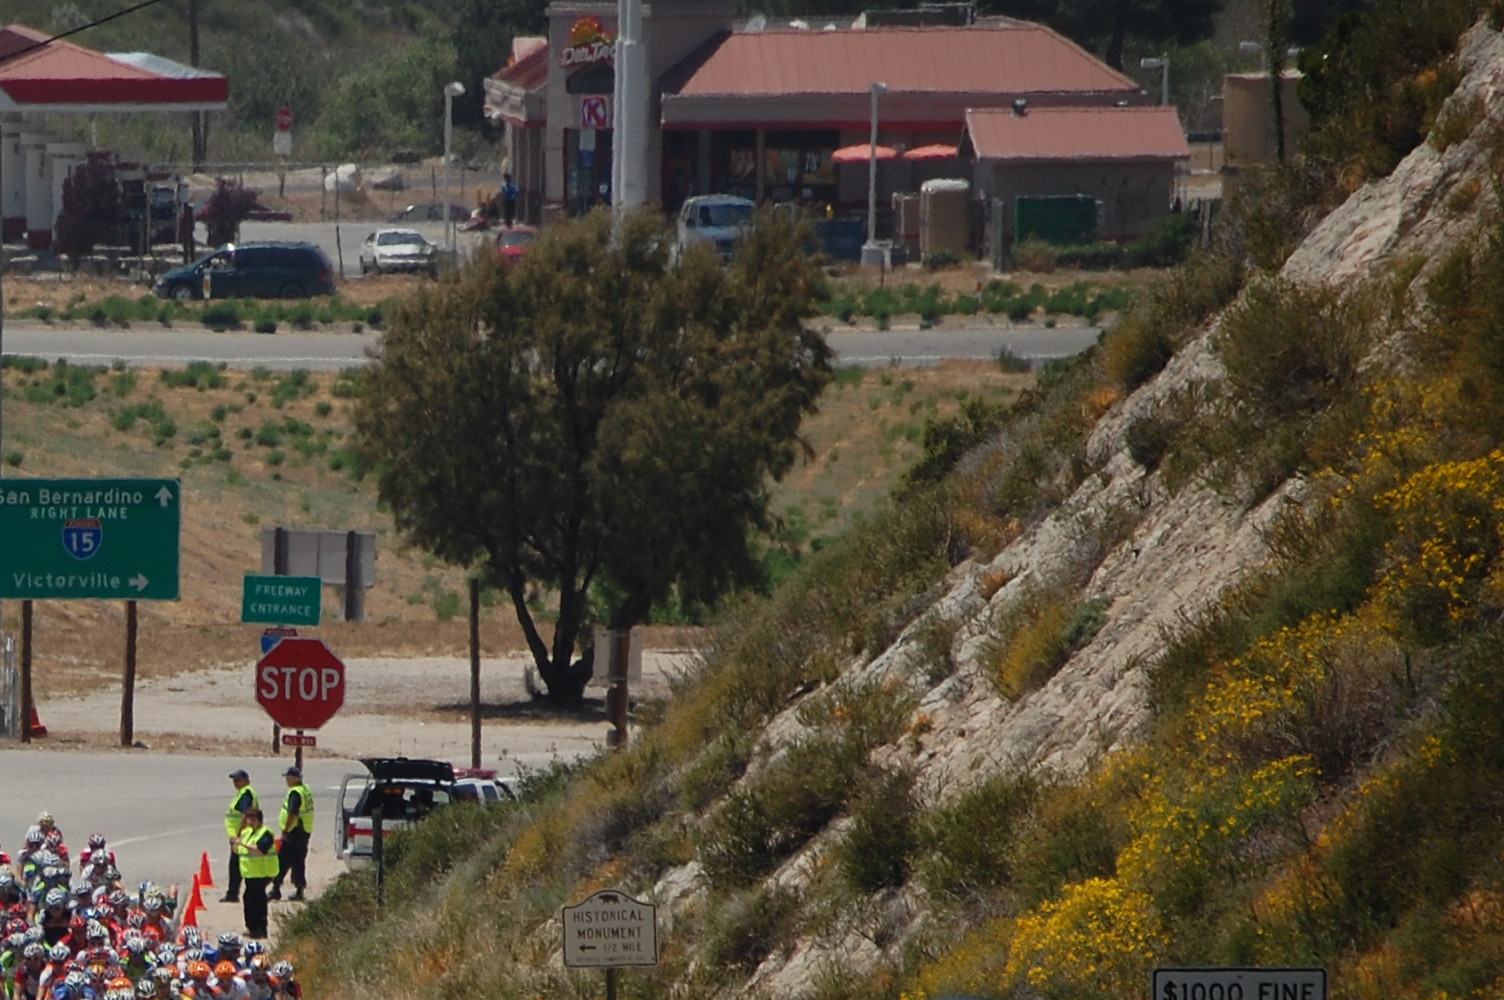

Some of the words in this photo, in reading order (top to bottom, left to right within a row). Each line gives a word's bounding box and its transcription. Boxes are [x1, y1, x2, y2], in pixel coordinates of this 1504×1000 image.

[39, 488, 143, 504] Bernardino
[30, 507, 78, 519] RIGHT
[87, 507, 127, 519] LANE
[72, 532, 94, 552] 15
[13, 573, 120, 588] Victorville
[255, 584, 308, 597] FREEWAY
[251, 603, 311, 616] ENTRANCE
[261, 666, 340, 700] STOP
[573, 910, 644, 923] HISTORICAL
[577, 927, 642, 939] MONUMENT
[603, 944, 617, 952] 1/2
[622, 943, 642, 952] MILE
